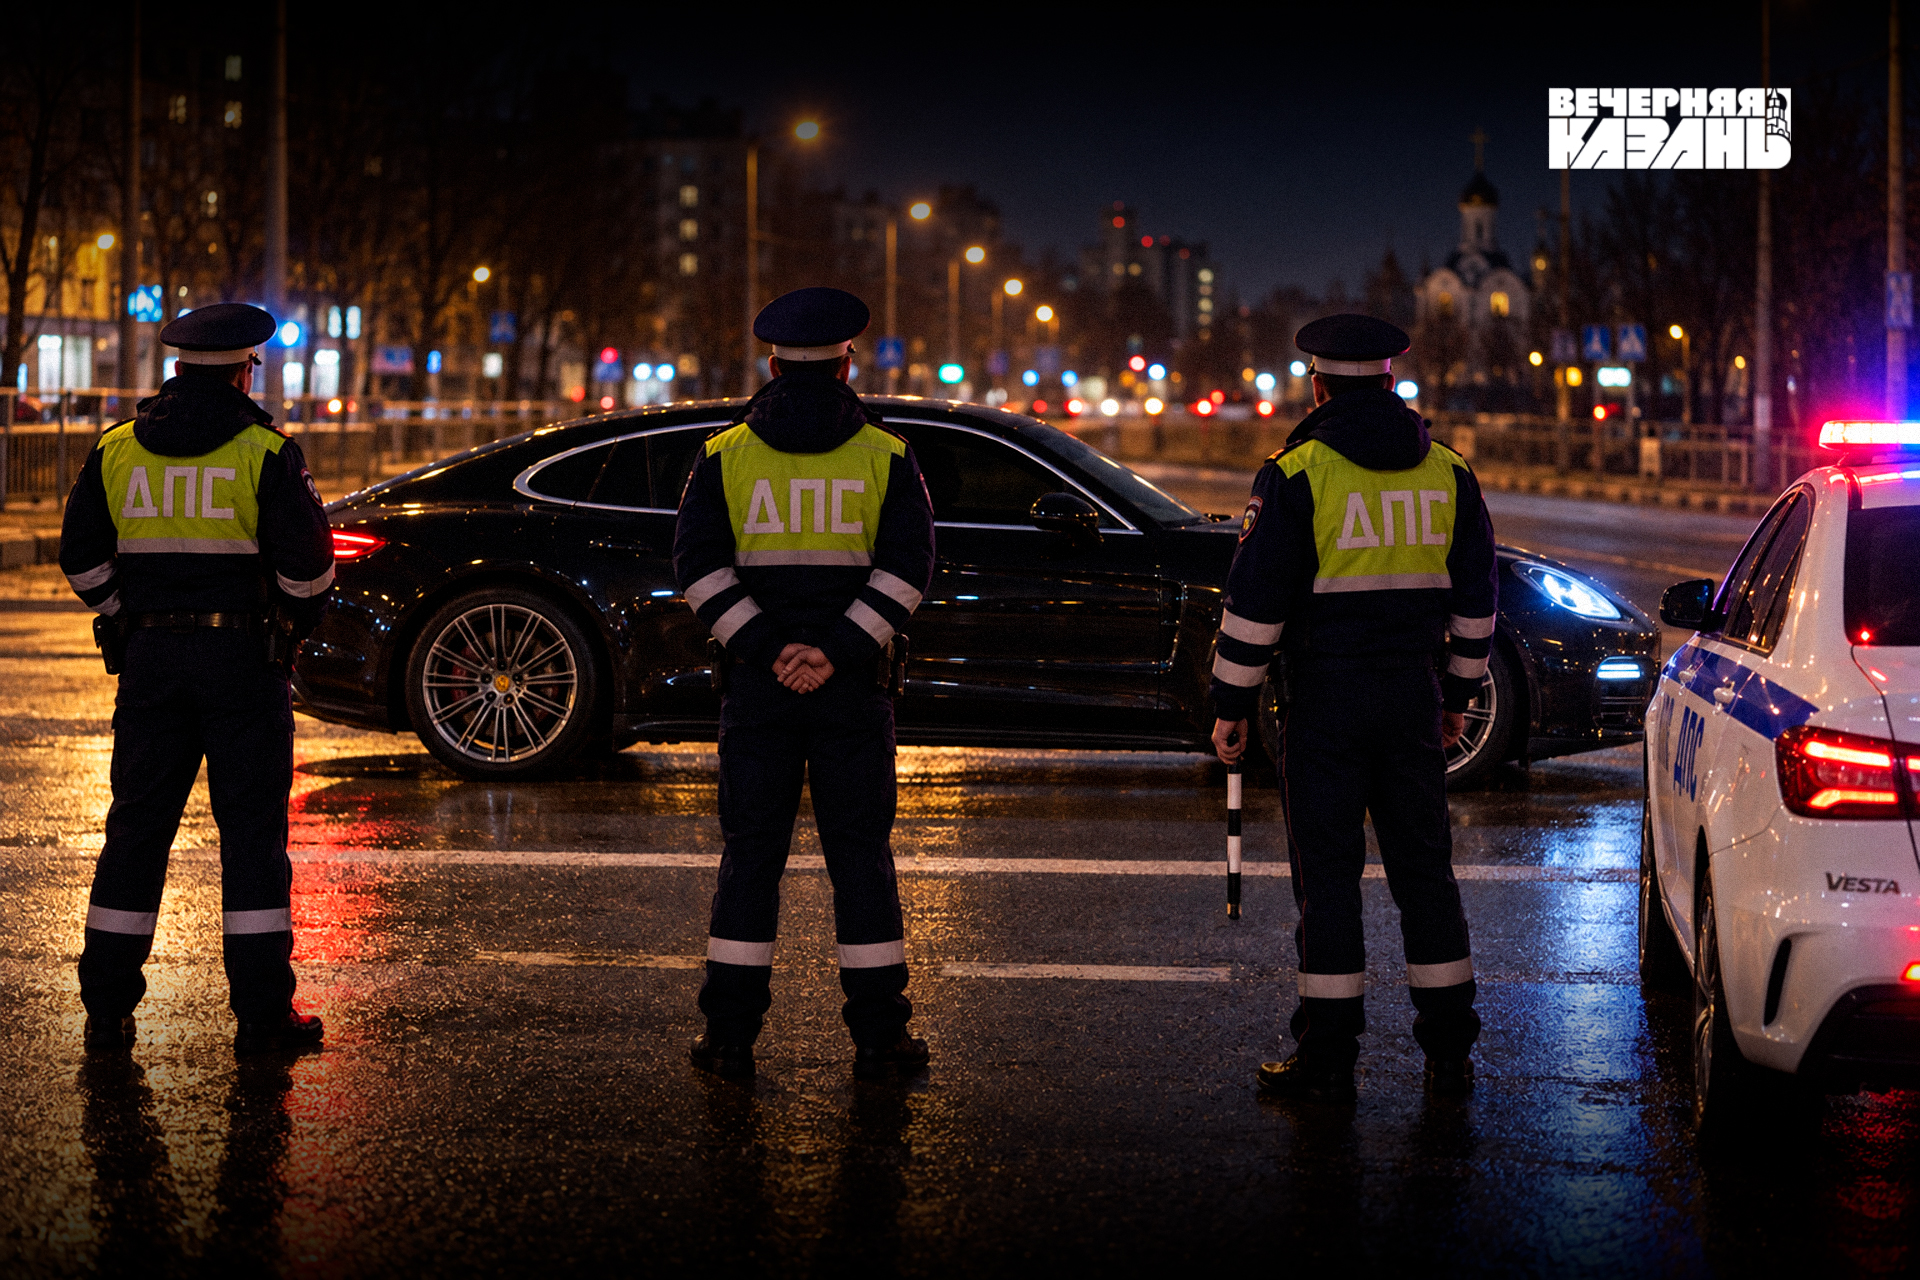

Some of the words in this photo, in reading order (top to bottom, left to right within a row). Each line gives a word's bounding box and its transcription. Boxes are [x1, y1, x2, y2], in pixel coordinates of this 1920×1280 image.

[122, 466, 237, 519] ДПС
[743, 478, 865, 534] ДПС
[1335, 490, 1449, 550] ДПС
[1673, 706, 1705, 802] ДПС
[1826, 872, 1901, 894] VESTA
